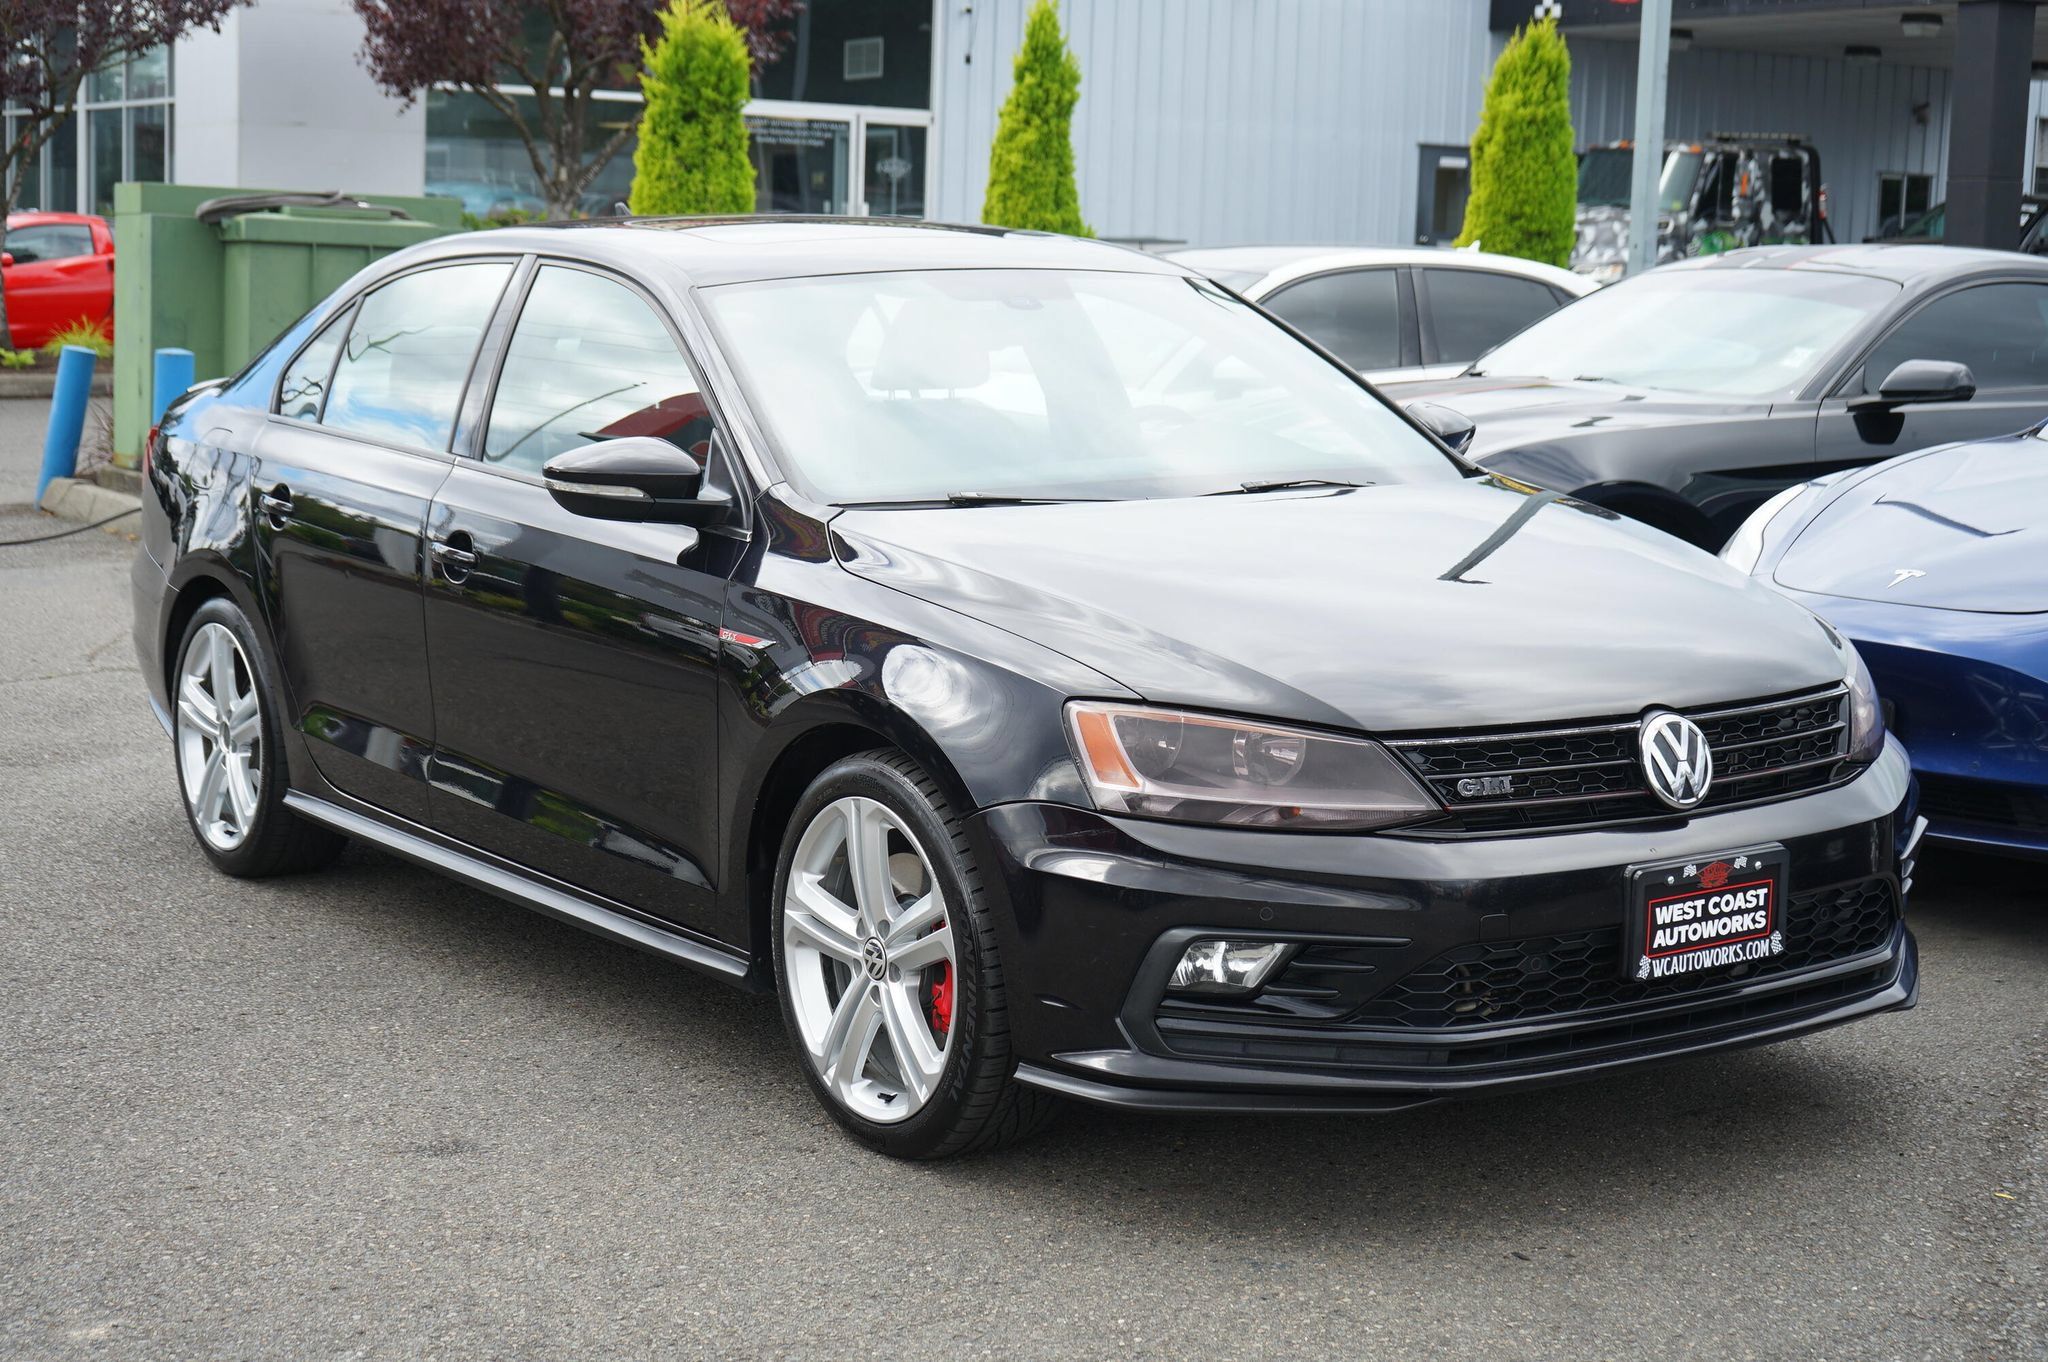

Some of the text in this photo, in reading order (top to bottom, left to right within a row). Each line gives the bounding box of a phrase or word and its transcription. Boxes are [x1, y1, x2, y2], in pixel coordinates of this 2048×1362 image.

[1457, 776, 1514, 797] GLI
[1655, 888, 1768, 925] WEST COAST
[1652, 910, 1766, 949] AUTOWORKS
[1652, 939, 1769, 977] WCAUTOWORKS.COM
